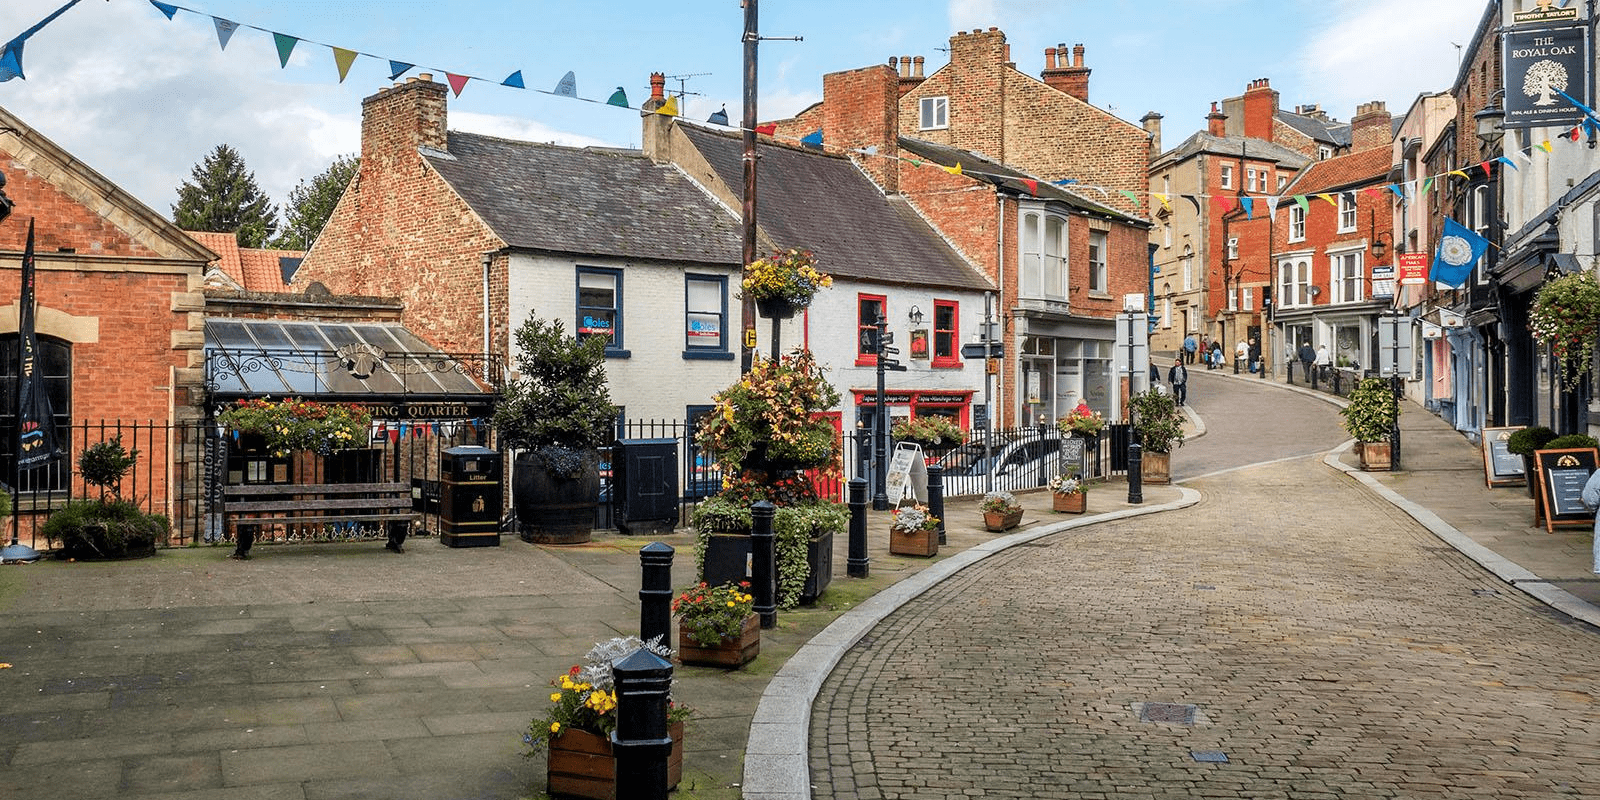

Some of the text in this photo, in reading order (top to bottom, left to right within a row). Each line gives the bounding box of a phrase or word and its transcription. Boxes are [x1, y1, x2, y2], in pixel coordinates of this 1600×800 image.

[1516, 9, 1576, 20] TIMOTHY TAYLOR'S
[1534, 36, 1554, 46] THE
[1512, 45, 1577, 59] ROYAL OAK
[408, 405, 469, 418] QUARTER
